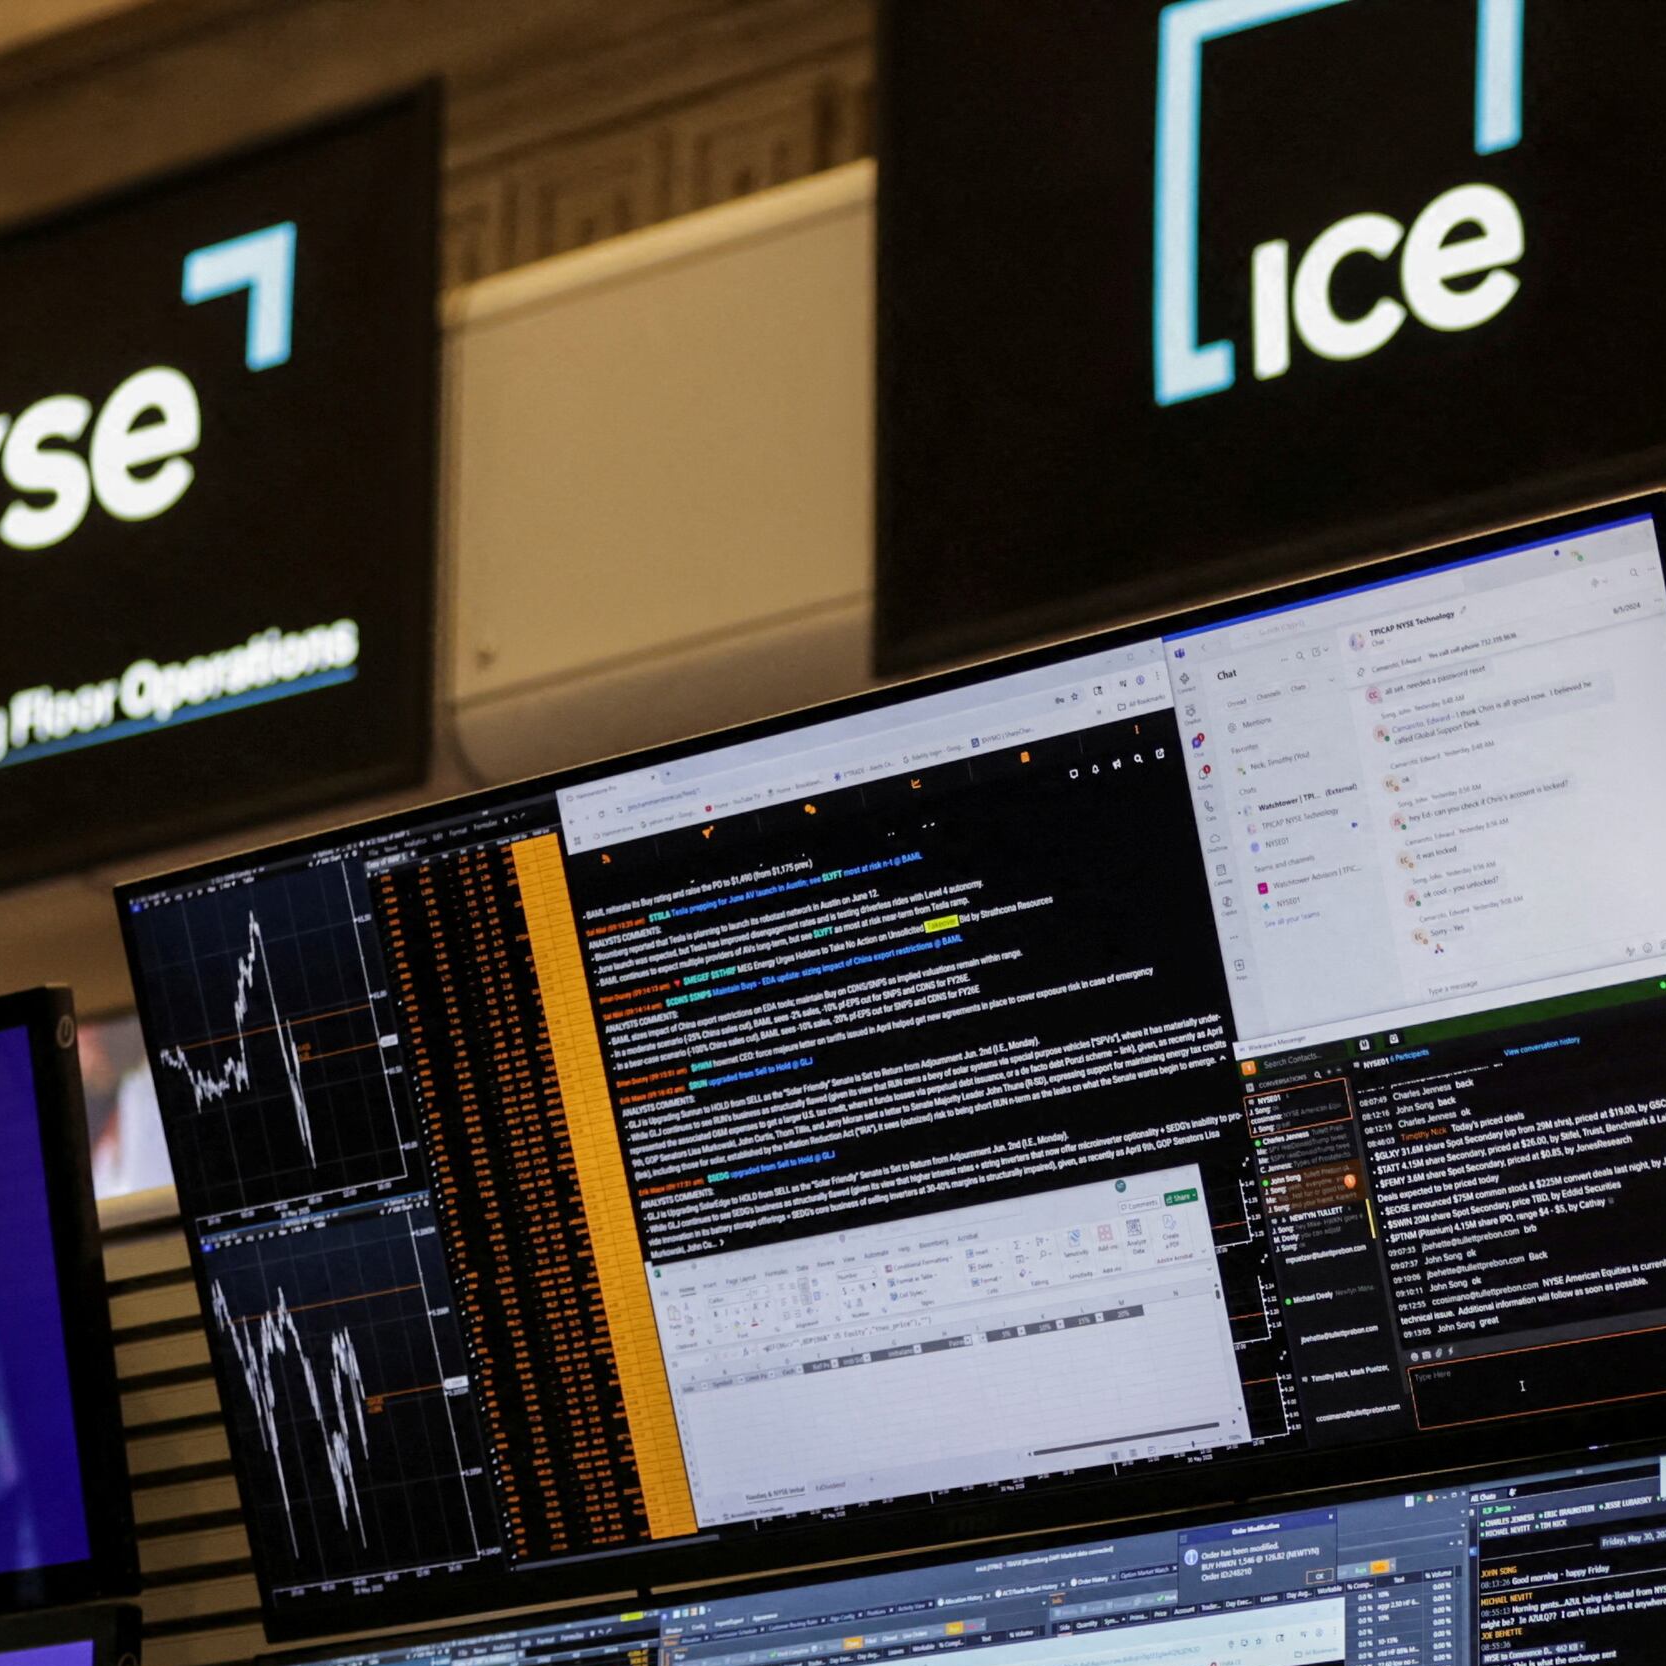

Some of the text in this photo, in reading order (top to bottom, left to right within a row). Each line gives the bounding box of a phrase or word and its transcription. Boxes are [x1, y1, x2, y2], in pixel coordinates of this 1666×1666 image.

[9, 685, 120, 747] Floor
[120, 619, 360, 723] Operations
[1217, 669, 1236, 680] Chat
[1362, 1057, 1389, 1068] NYSE01
[1394, 1049, 1429, 1060] Participants
[1374, 1148, 1399, 1161] $GLXY
[1400, 1144, 1423, 1156] 31.6M
[1424, 1141, 1445, 1151] share
[1445, 1137, 1463, 1148] Spot
[1463, 1130, 1503, 1144] Secondary
[1503, 1128, 1516, 1138] (up
[1517, 1125, 1535, 1134] from
[1535, 1119, 1553, 1131] 29M
[1574, 1111, 1598, 1125] priced
[1599, 1110, 1608, 1119] at
[1608, 1104, 1637, 1117] $19.00,
[1637, 1103, 1648, 1112] by
[1401, 1131, 1428, 1139] Timothy
[1450, 1120, 1479, 1132] Today's
[1479, 1115, 1503, 1128] priced
[1503, 1111, 1524, 1122] deals
[1376, 1174, 1499, 1203] Deals expected to be priced today
[1400, 1277, 1648, 1325] technical issue. Additional information will follow as soon as possible.
[1200, 1541, 1279, 1560] Order has been modified.
[1511, 1575, 1529, 1585] Good
[1530, 1571, 1558, 1582] morning
[1565, 1568, 1586, 1578] happy
[1587, 1564, 1609, 1574] Friday
